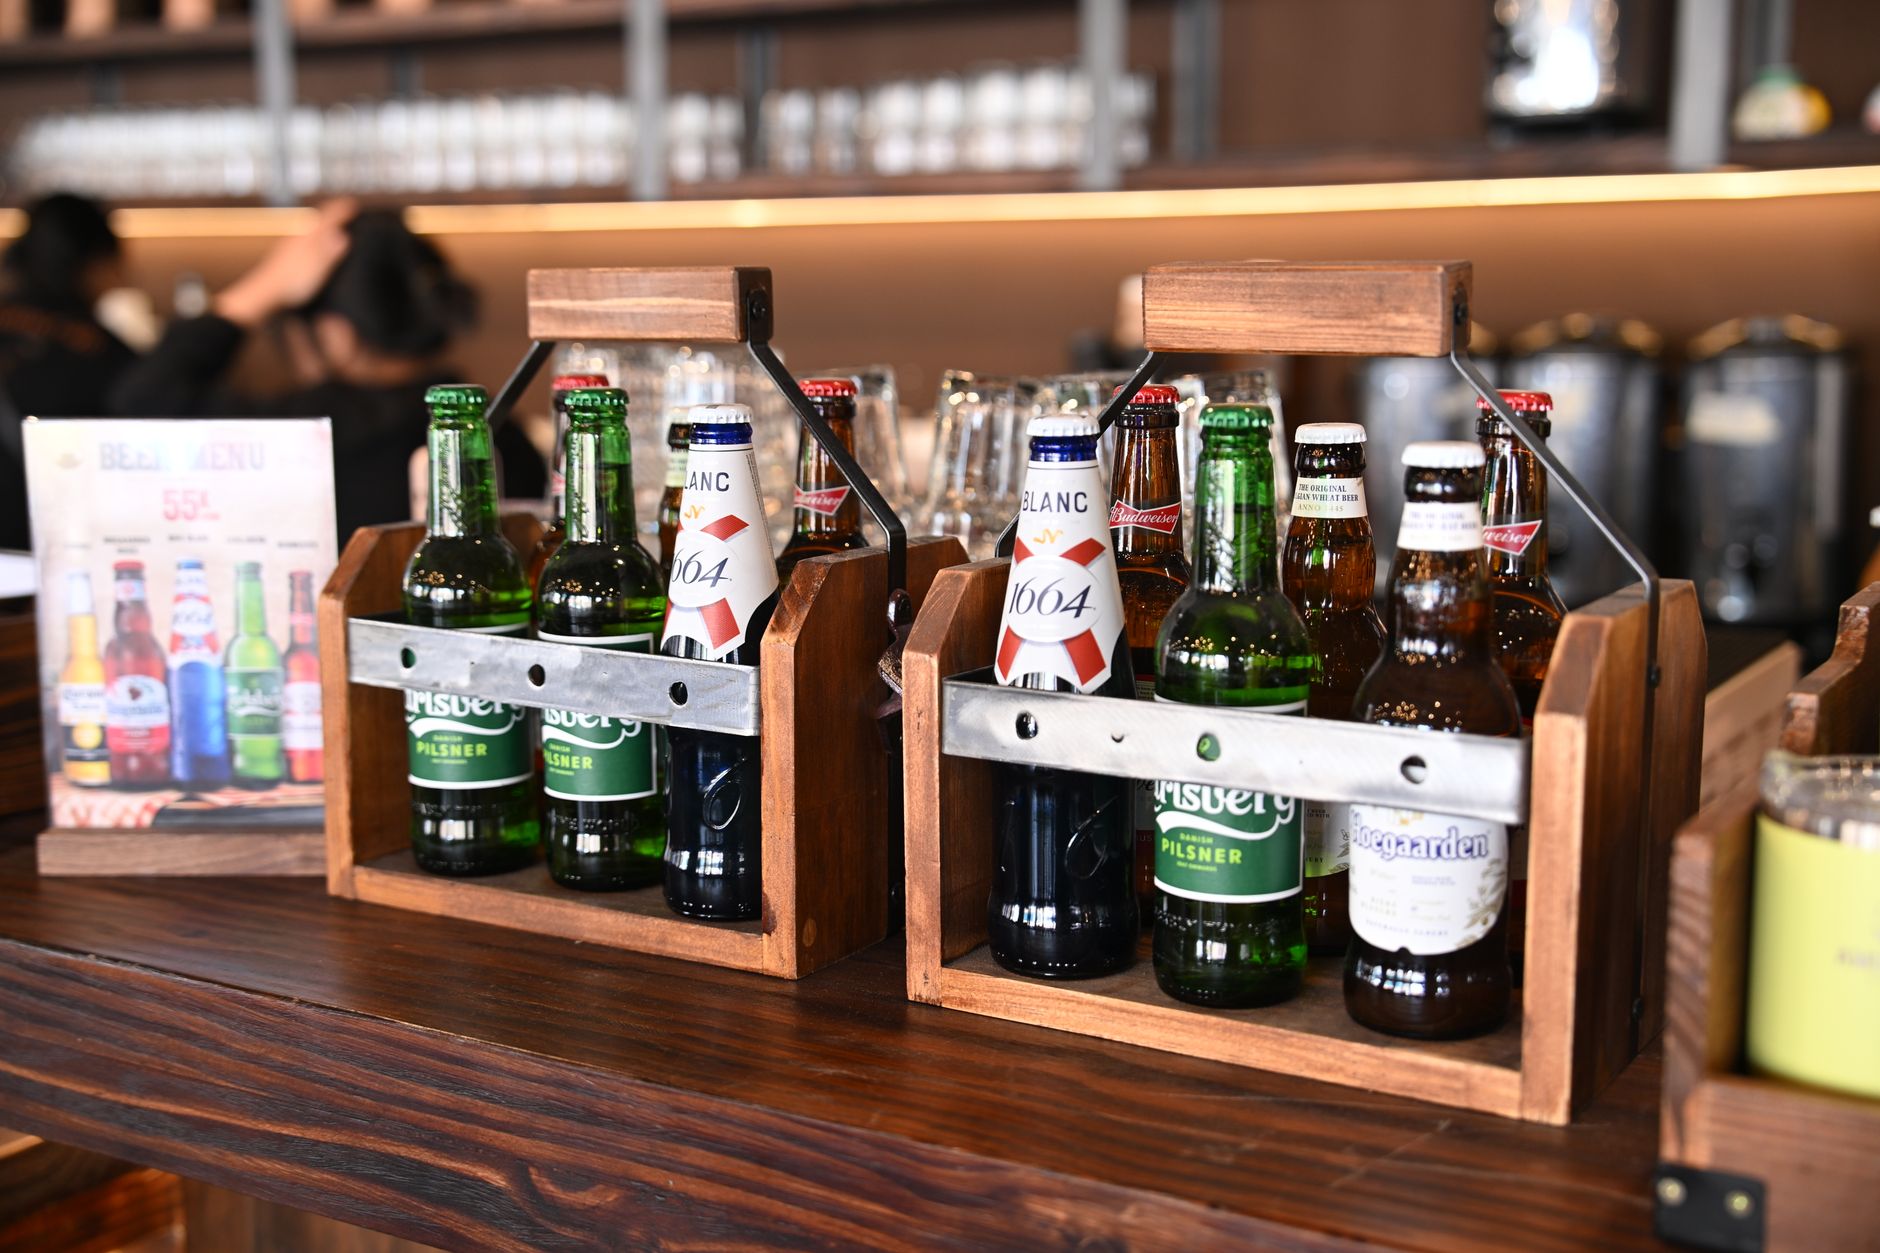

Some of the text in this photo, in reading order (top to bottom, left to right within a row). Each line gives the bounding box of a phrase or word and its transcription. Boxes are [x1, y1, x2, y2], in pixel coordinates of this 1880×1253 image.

[685, 471, 730, 492] ANC
[1310, 485, 1347, 493] ORIGINAL
[1022, 490, 1088, 514] BLANC
[1342, 494, 1359, 502] BEER
[1110, 506, 1178, 524] Budweiser
[1008, 577, 1093, 619] 1664
[416, 741, 488, 758] PILSNER
[1161, 837, 1242, 865] PILSNER
